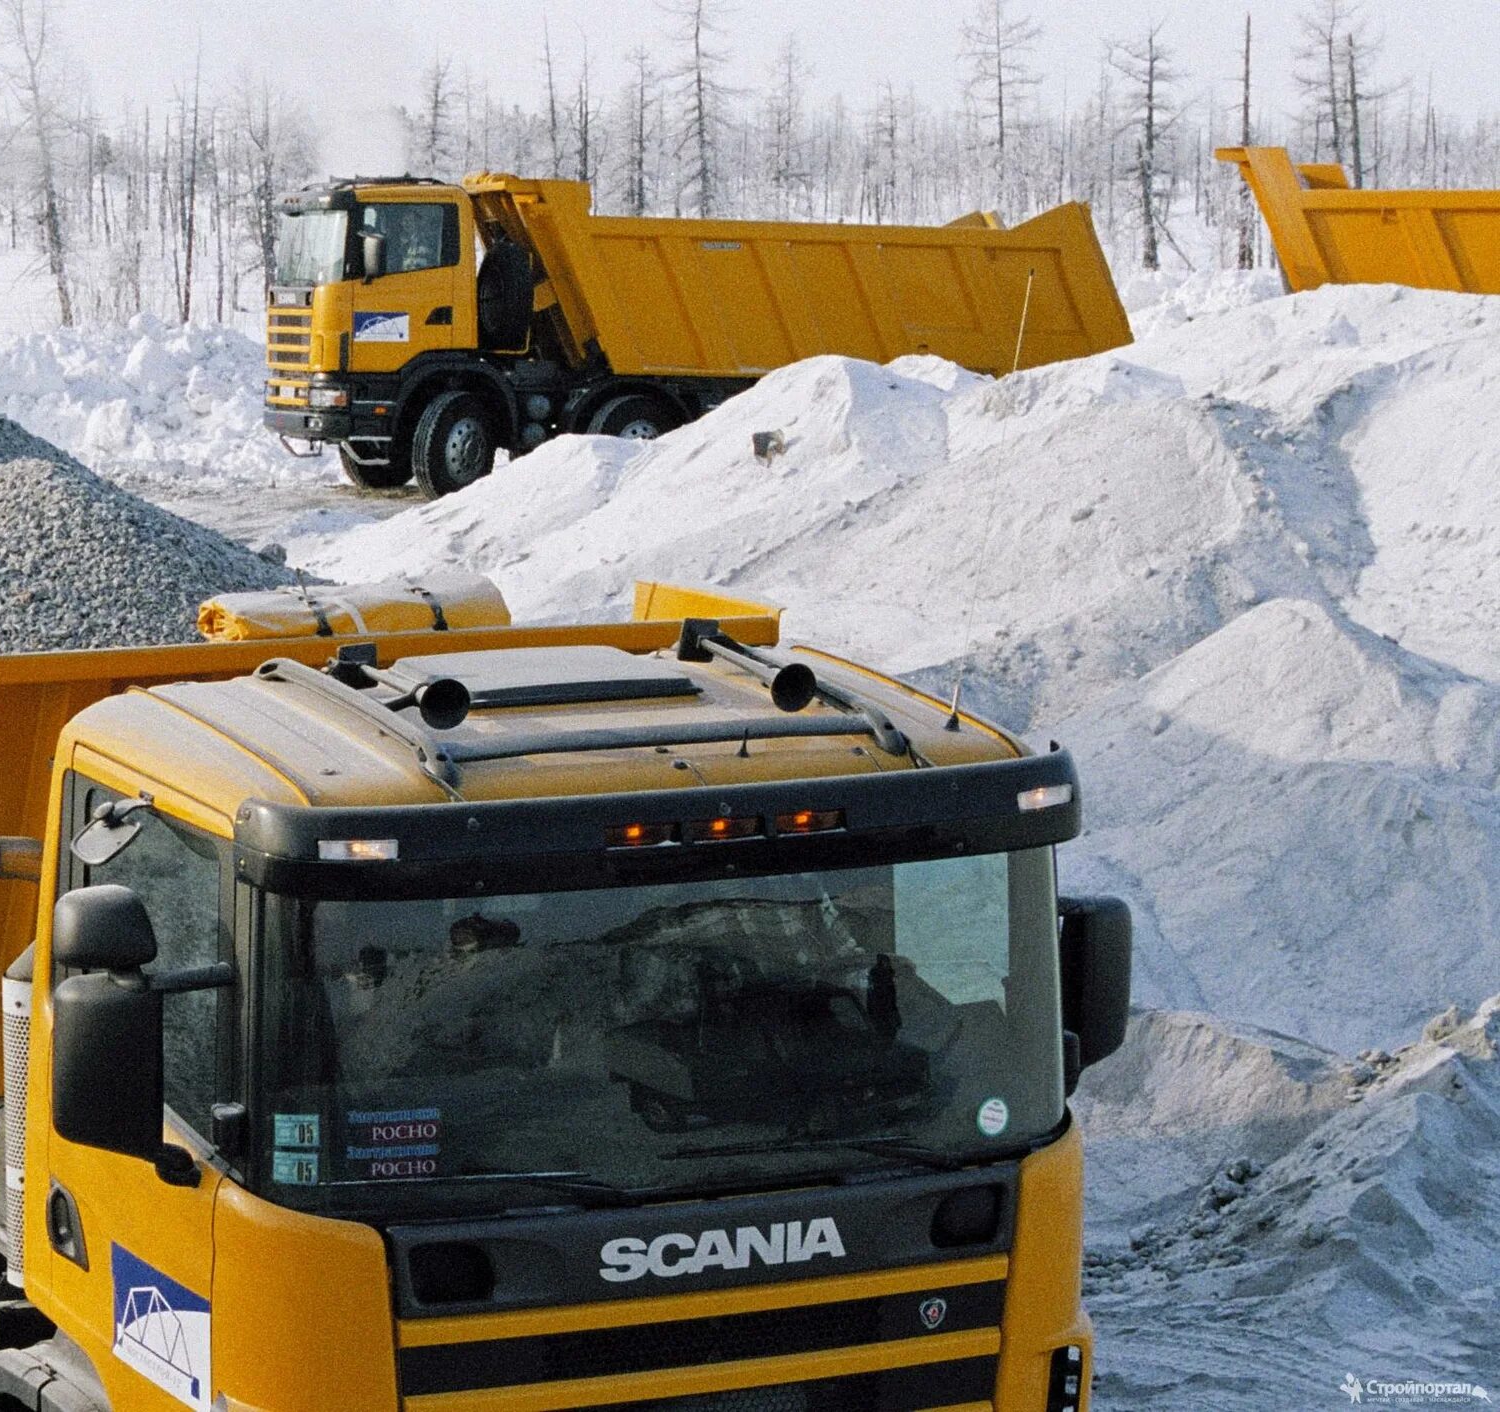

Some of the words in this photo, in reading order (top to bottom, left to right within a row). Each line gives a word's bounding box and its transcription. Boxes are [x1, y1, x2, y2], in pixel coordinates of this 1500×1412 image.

[372, 1123, 437, 1141] РОСНО
[371, 1159, 436, 1176] РОСНО
[599, 1217, 846, 1282] SCANIA
